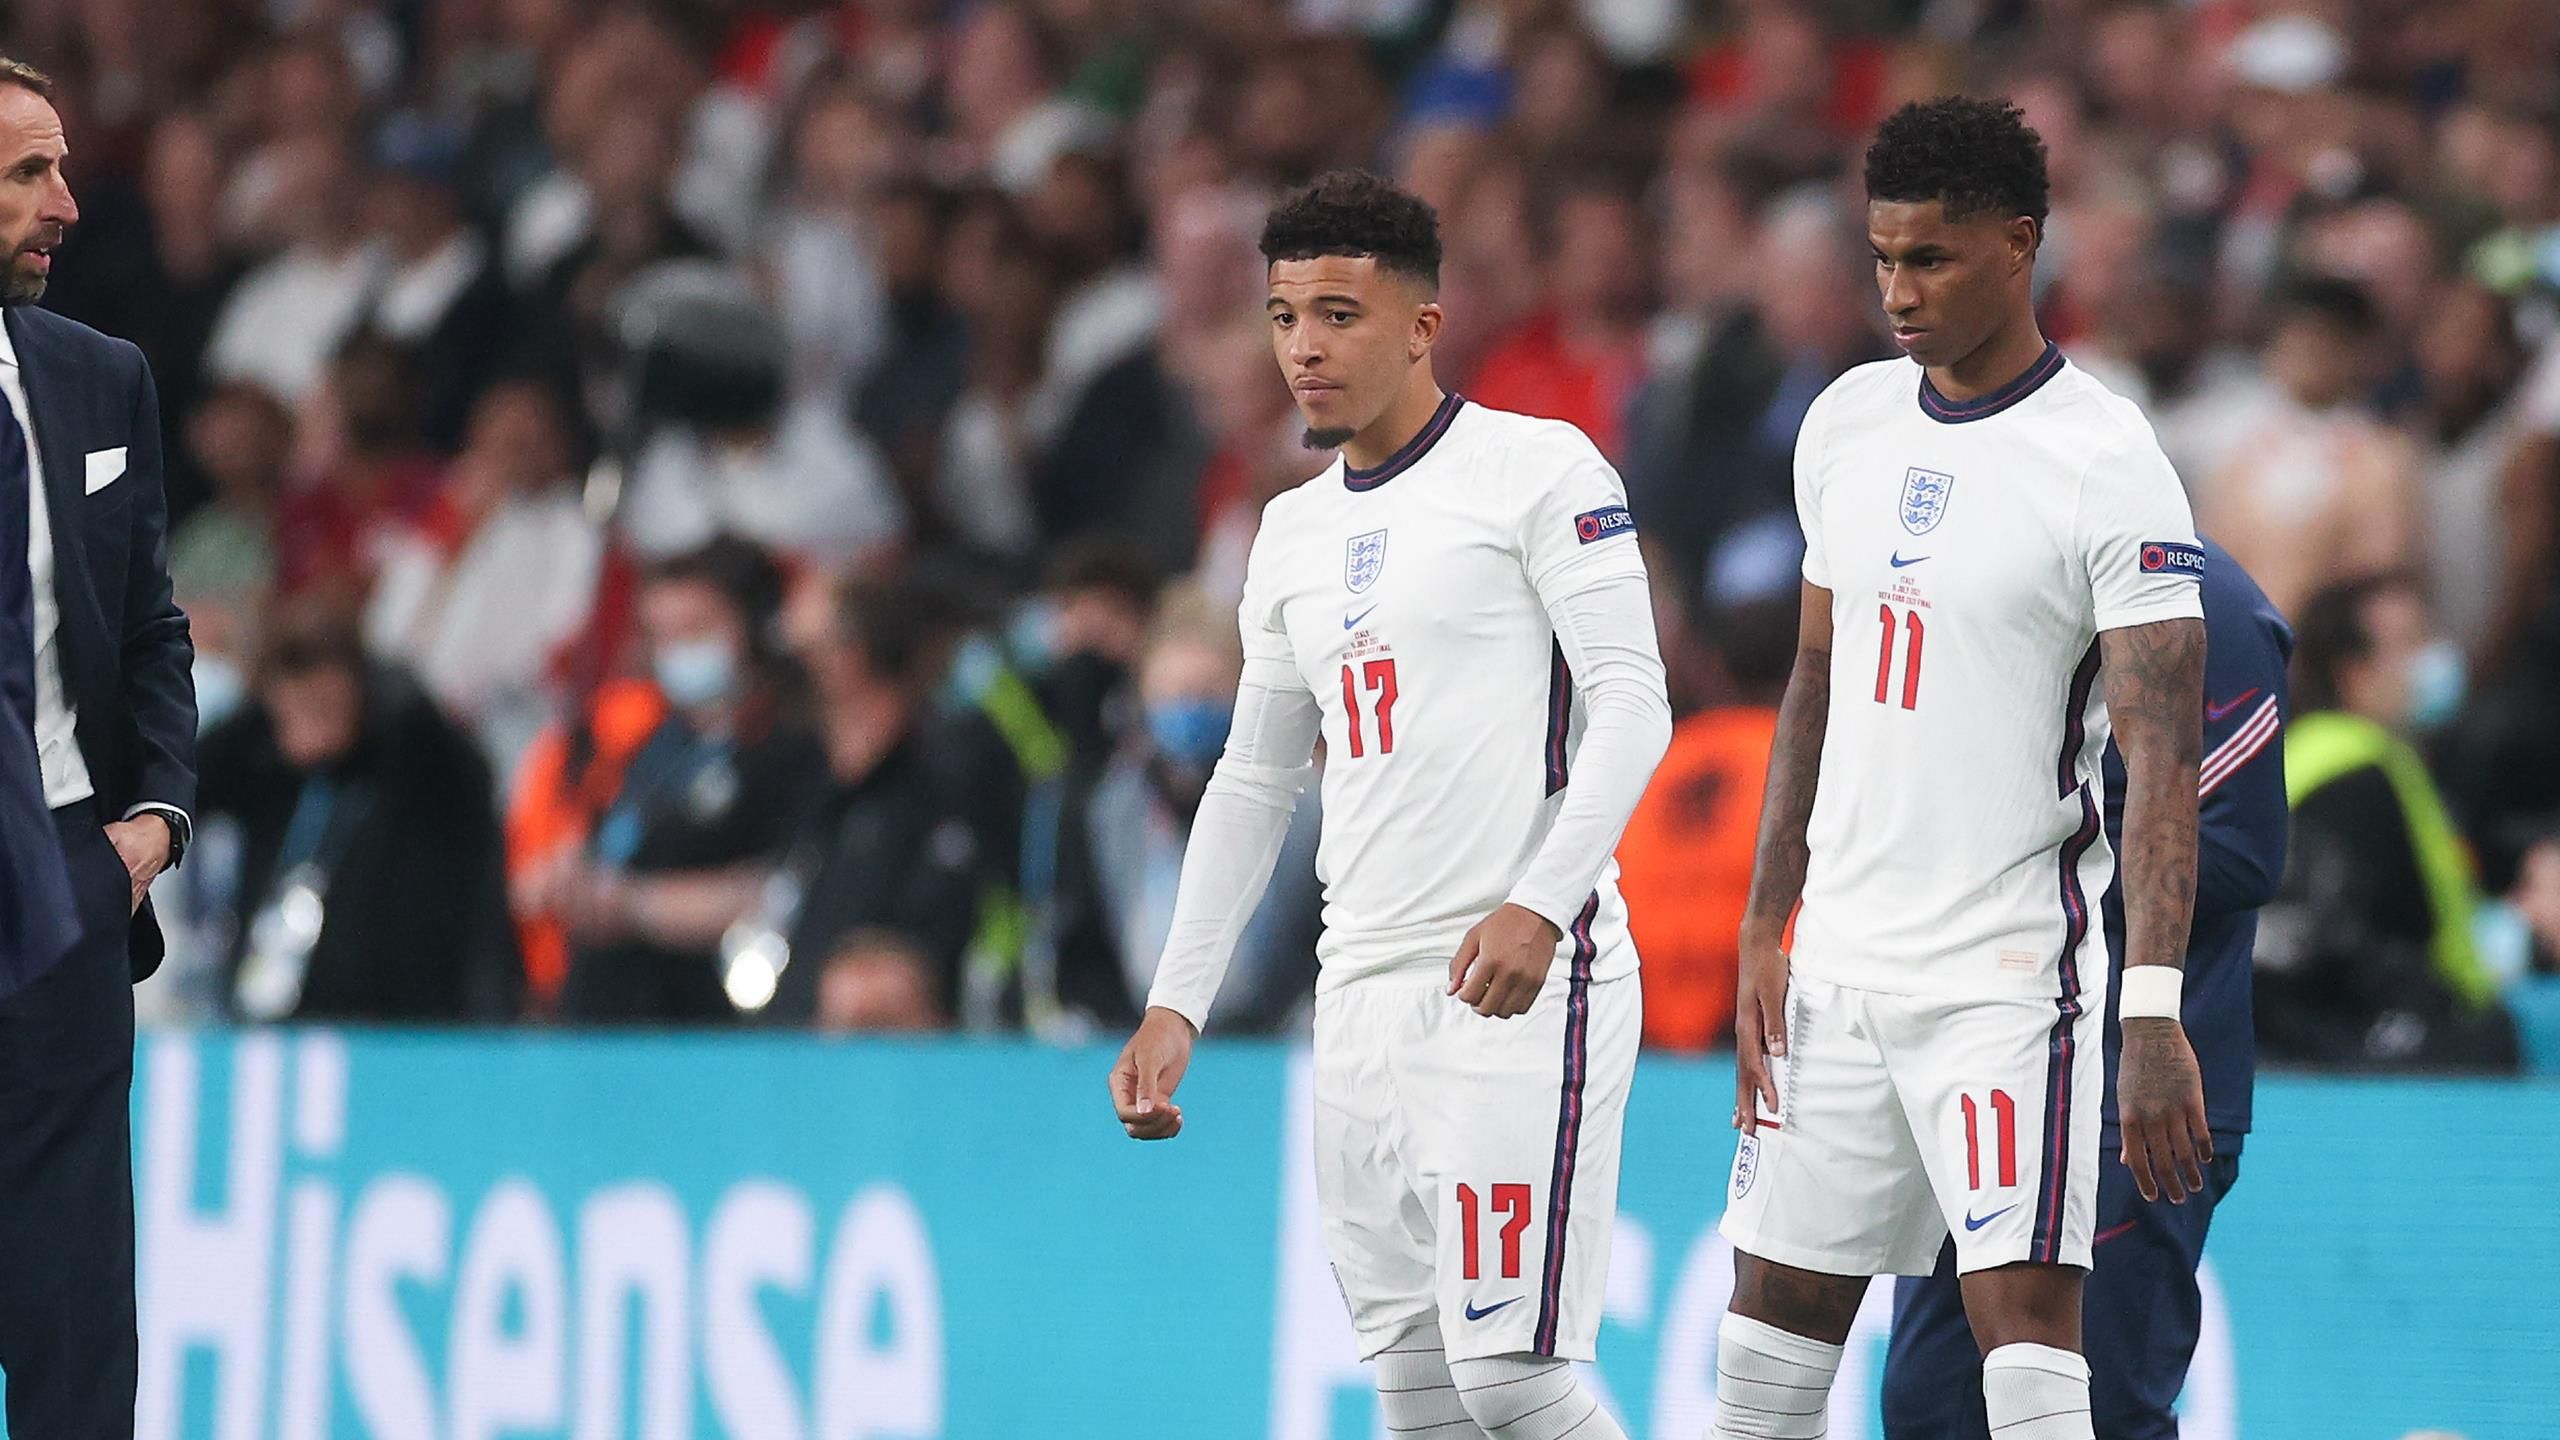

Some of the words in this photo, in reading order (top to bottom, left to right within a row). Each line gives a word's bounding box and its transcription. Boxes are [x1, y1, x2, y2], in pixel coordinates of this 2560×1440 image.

[1341, 658, 1399, 759] 17
[1874, 603, 1924, 711] 11
[1961, 1088, 2017, 1191] 11
[136, 1034, 945, 1440] Hisense
[1456, 1183, 1531, 1280] 17
